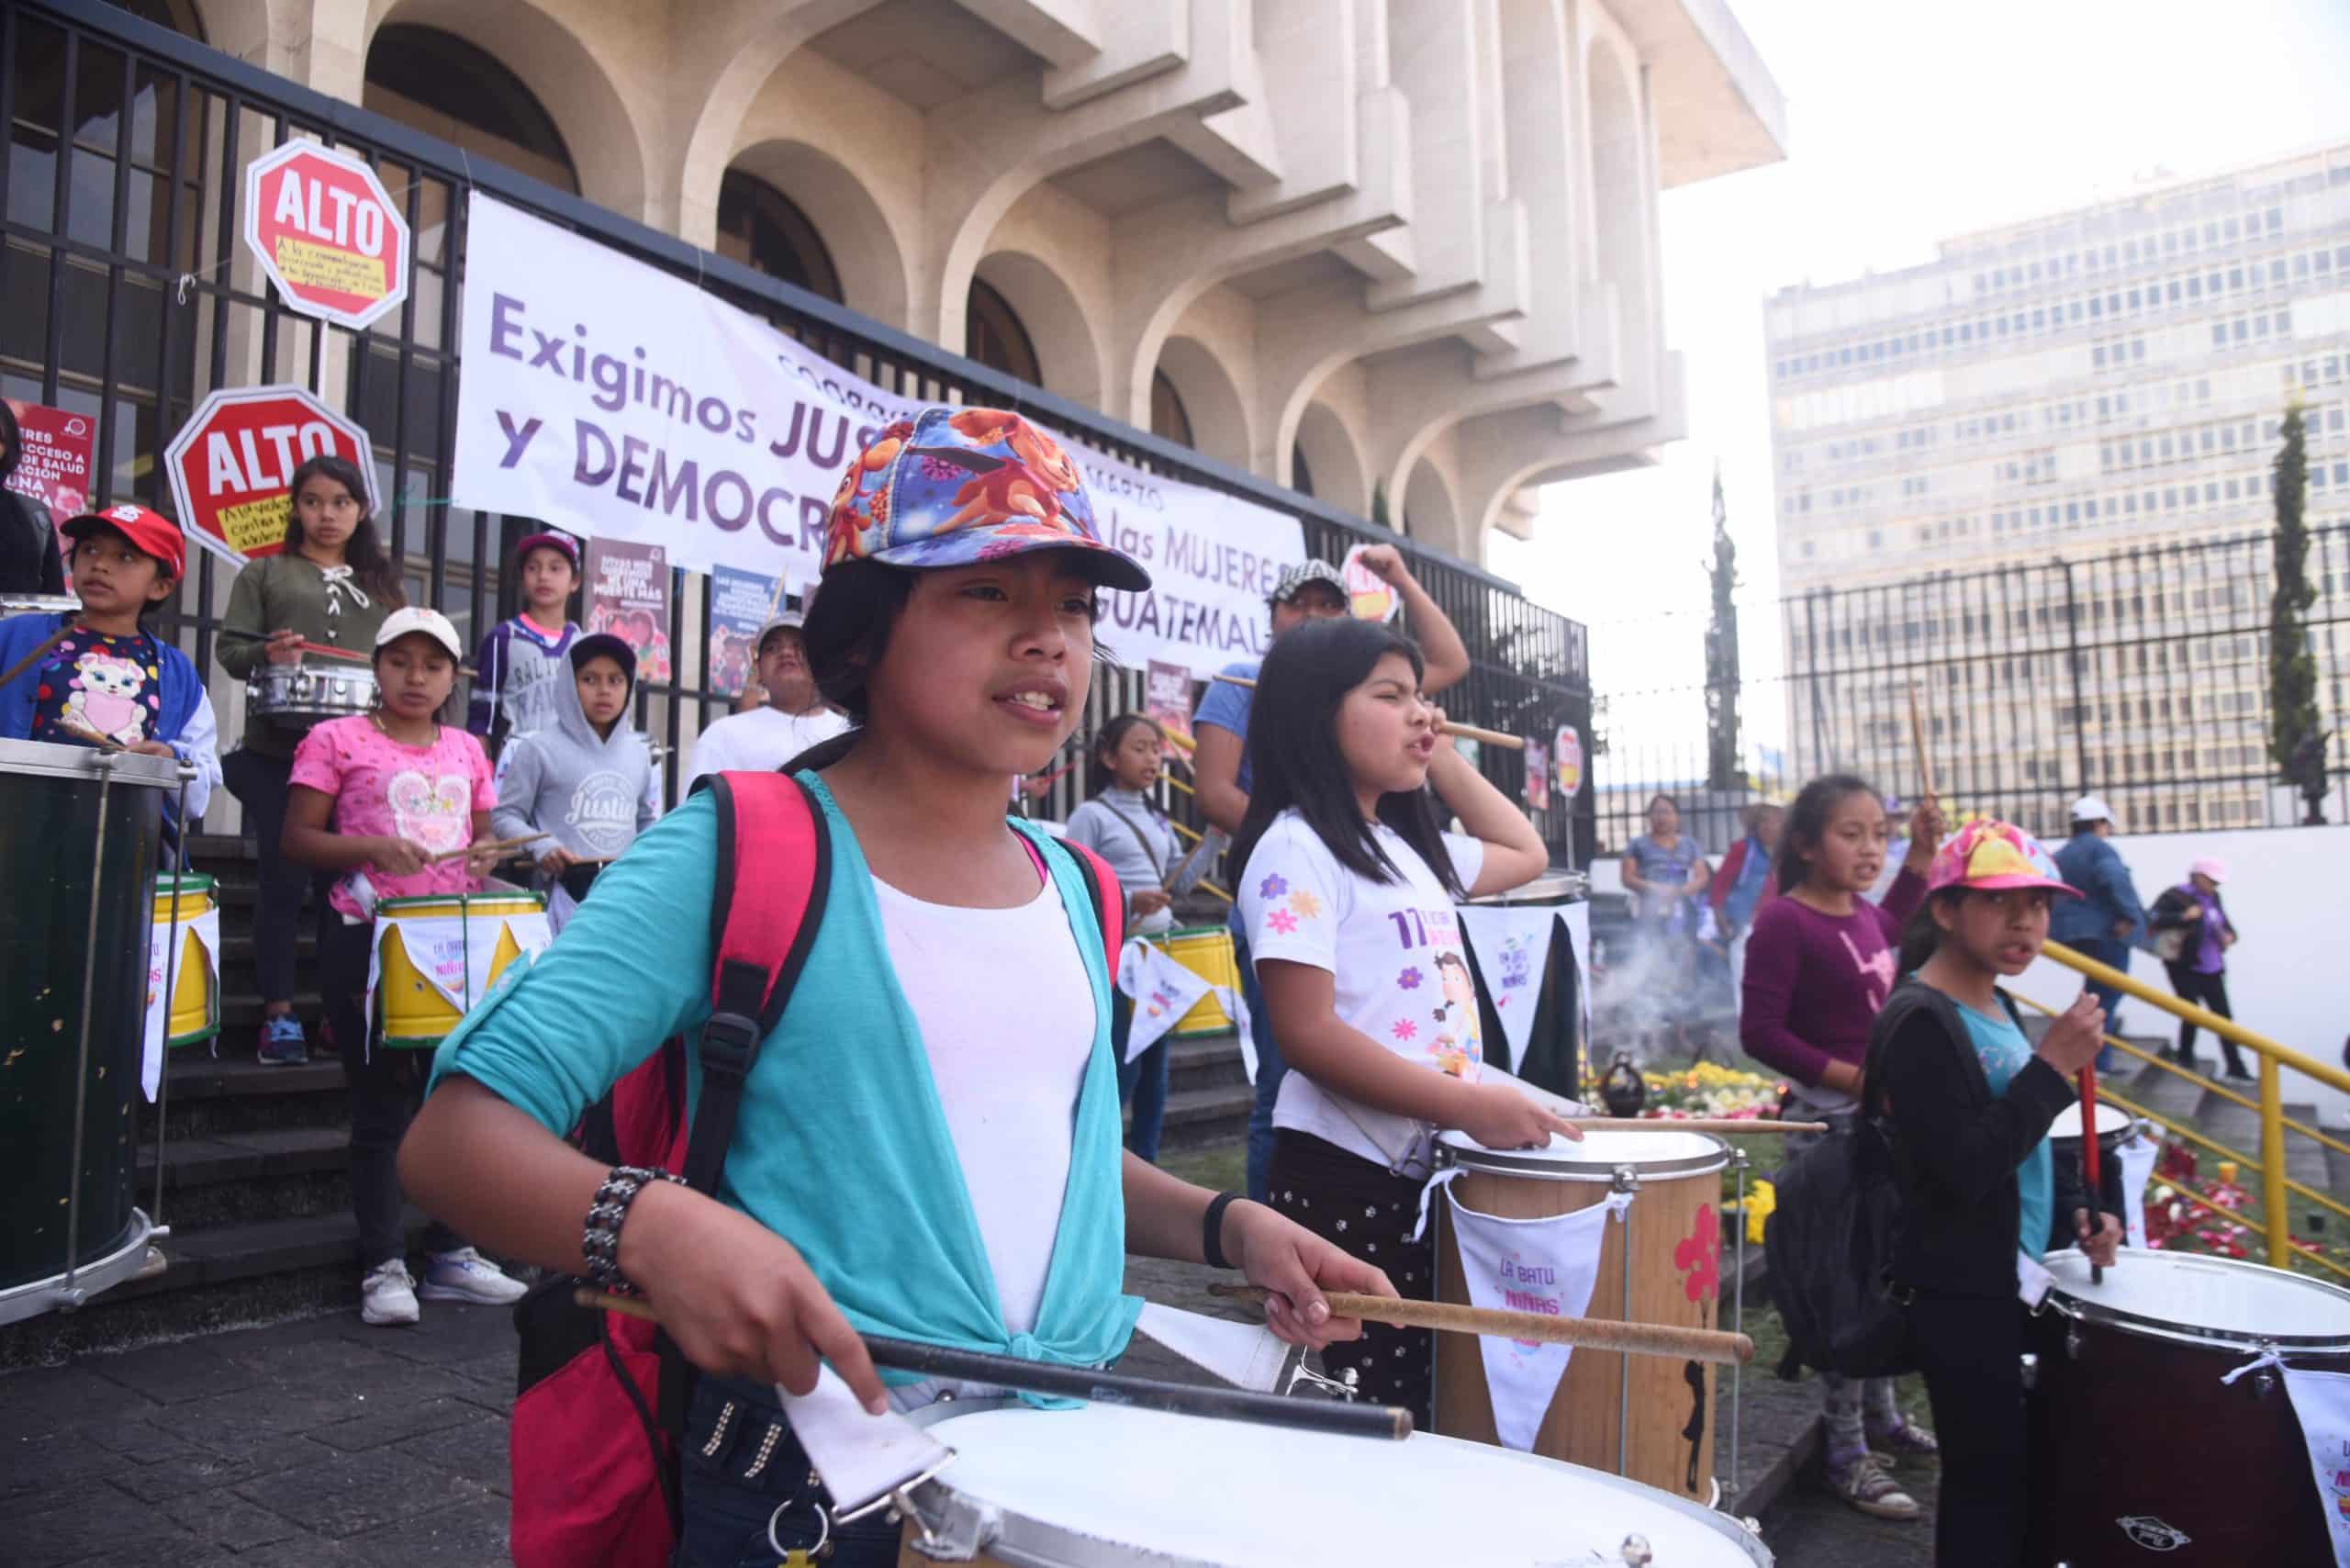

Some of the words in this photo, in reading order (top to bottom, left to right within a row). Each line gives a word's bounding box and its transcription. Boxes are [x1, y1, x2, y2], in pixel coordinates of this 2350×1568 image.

[274, 168, 384, 258] ALTO
[207, 421, 337, 496] ALTO
[489, 292, 756, 442] Exigimos
[1110, 509, 1155, 561] las
[42, 458, 84, 475] SALUD
[1500, 1258, 1514, 1279] LA
[1518, 1266, 1555, 1285] BATU
